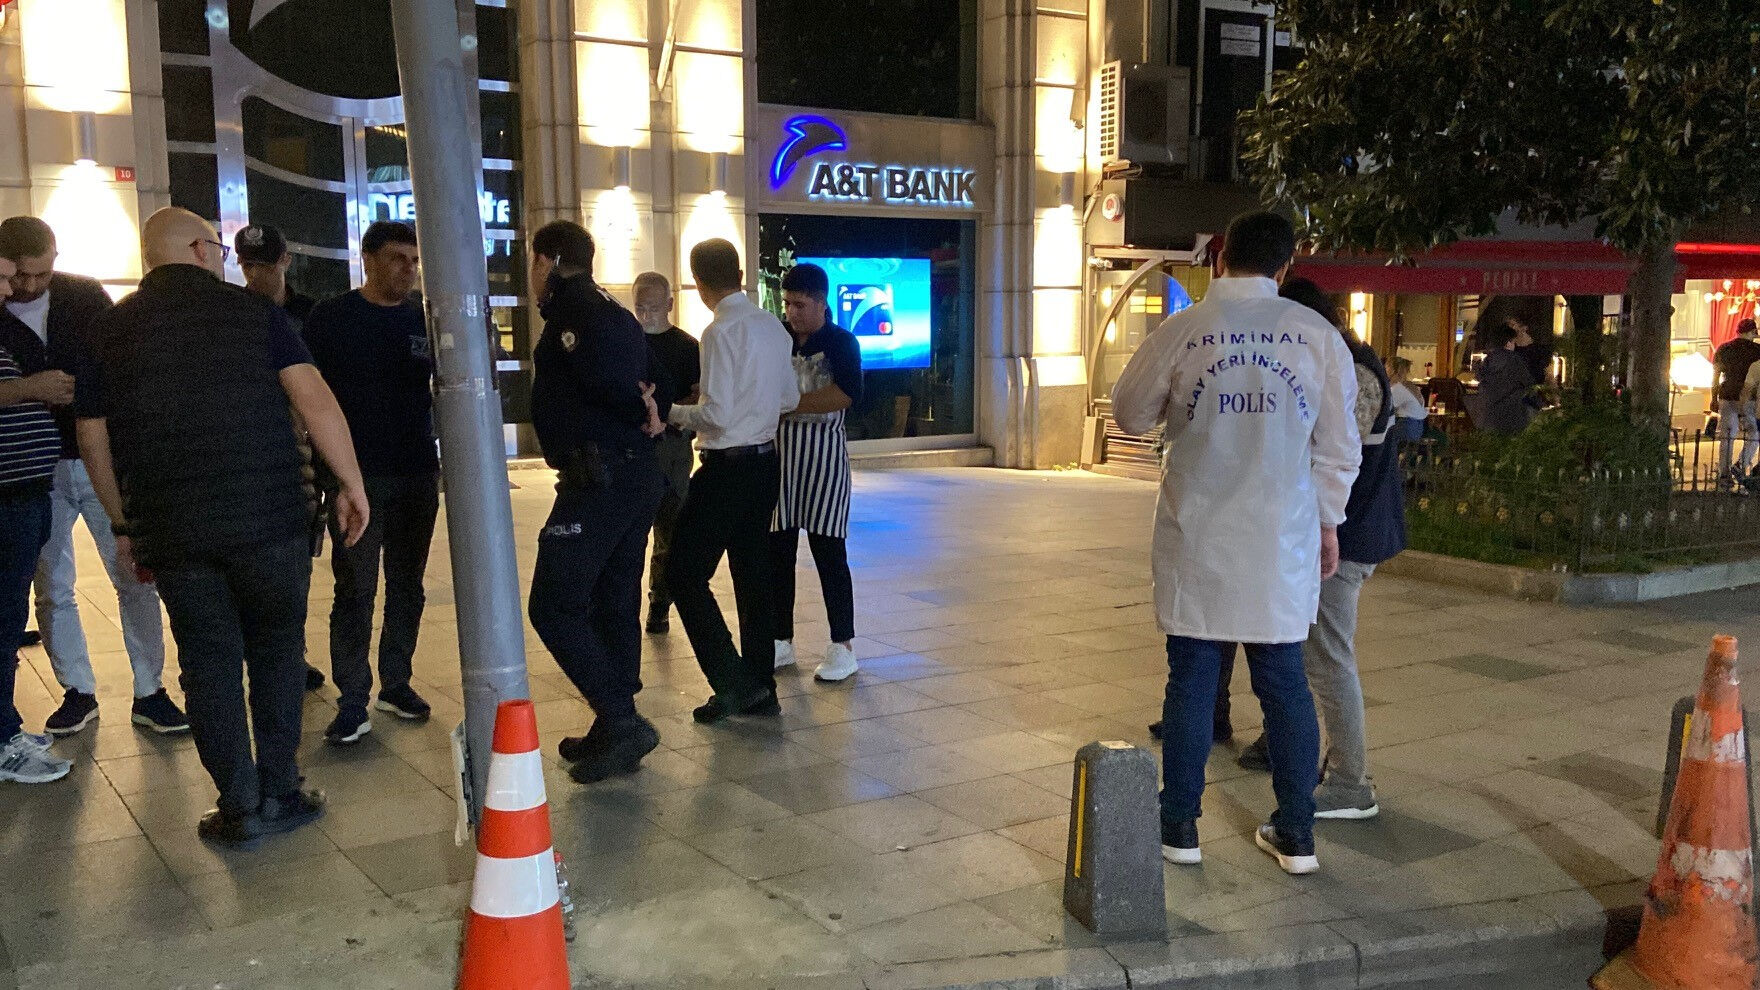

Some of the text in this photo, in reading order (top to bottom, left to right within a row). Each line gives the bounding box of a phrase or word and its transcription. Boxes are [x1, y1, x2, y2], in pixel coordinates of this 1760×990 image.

[120, 170, 131, 179] 10
[810, 163, 977, 205] A&T BANK
[1187, 377, 1205, 421] OLAY
[1207, 351, 1246, 377] YERİ
[1218, 387, 1277, 414] POLİS
